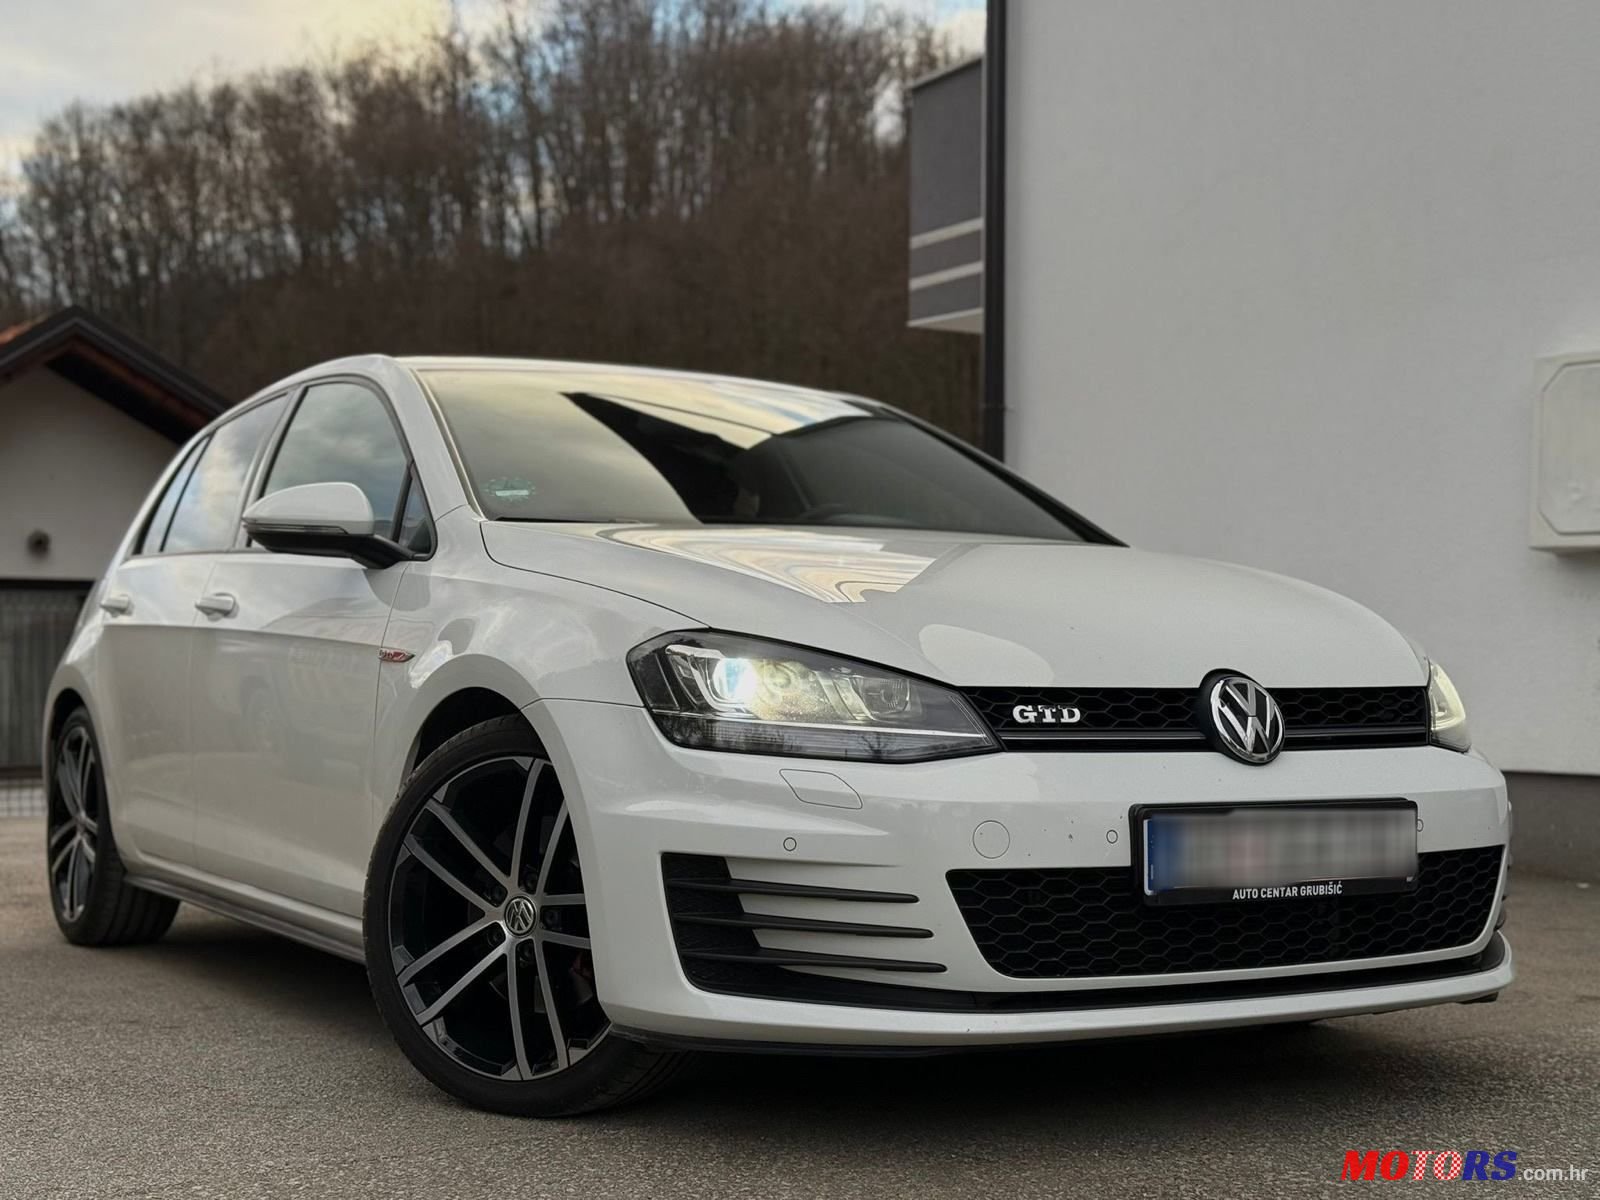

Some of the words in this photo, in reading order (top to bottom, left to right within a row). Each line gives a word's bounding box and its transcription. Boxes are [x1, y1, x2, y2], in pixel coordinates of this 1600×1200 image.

[1012, 704, 1081, 723] GTD
[1232, 887, 1258, 900] AUTO
[1260, 886, 1298, 899] CENTAR
[1300, 881, 1343, 896] GRUBIŠIĆ
